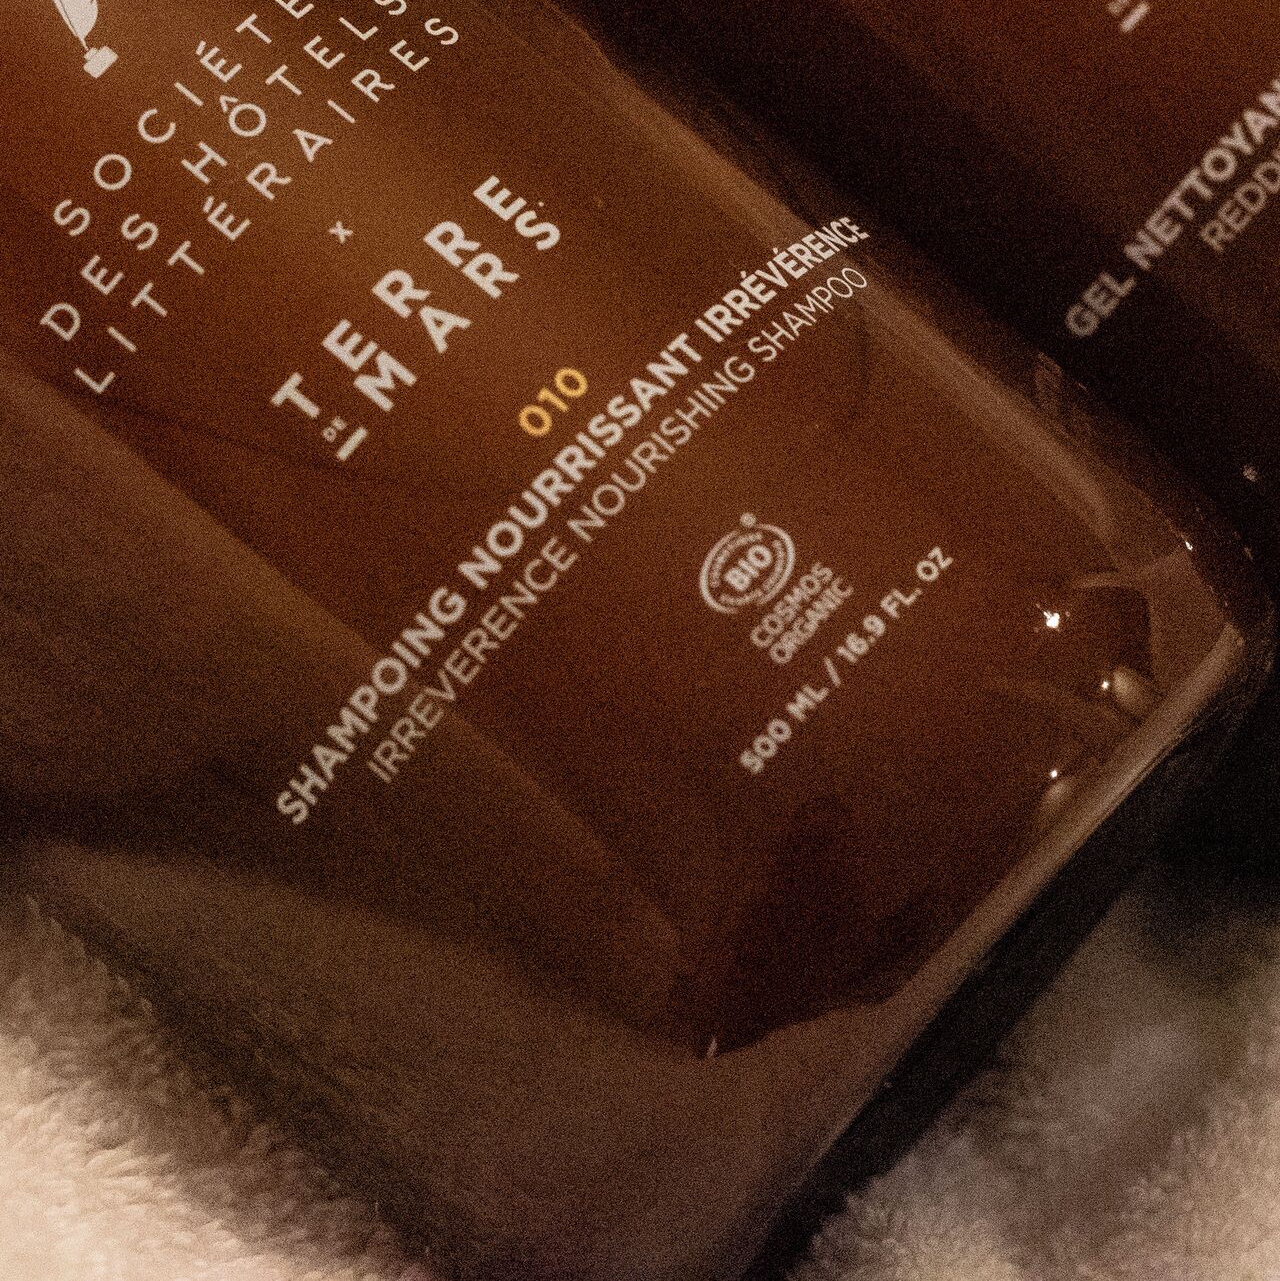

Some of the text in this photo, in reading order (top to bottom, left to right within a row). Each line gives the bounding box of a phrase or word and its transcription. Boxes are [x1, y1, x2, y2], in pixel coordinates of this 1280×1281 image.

[40, 212, 159, 341] DES
[74, 16, 460, 394] LITTÉRAIRES
[270, 175, 528, 418] TERRE
[353, 208, 562, 411] MARS
[1065, 271, 1136, 338] GEL
[519, 367, 588, 437] 010
[276, 216, 870, 825] SHAMPOING NOURRISSANT IRRÉVÉRENCE
[368, 267, 868, 783] IRREVERENCE NOURISHING SHAMPOO
[724, 544, 772, 591] BIO
[740, 718, 792, 775] 500
[786, 684, 829, 721] ML
[824, 656, 842, 687] /
[836, 615, 887, 663] 16.9
[916, 546, 954, 582] OZ
[750, 561, 834, 648] COSMOS
[771, 577, 854, 664] ORGANIC
